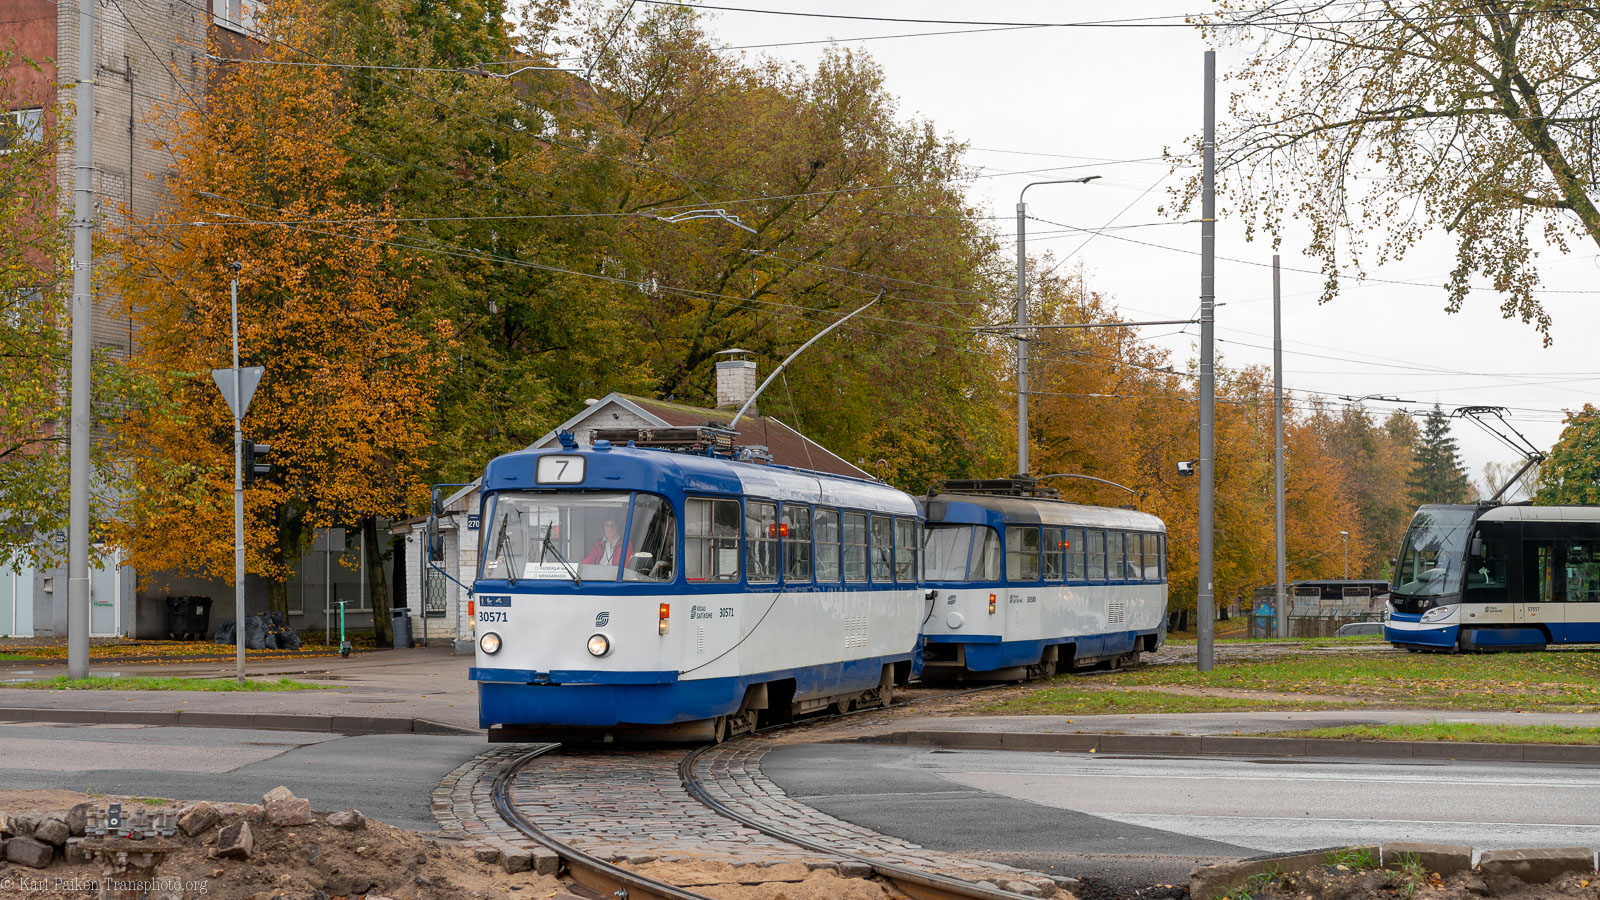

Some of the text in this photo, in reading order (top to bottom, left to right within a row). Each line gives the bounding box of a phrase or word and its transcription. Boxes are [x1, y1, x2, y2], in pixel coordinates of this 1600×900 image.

[556, 460, 569, 481] 7
[468, 520, 480, 528] 270
[479, 611, 508, 622] 30571
[719, 607, 734, 618] 30571
